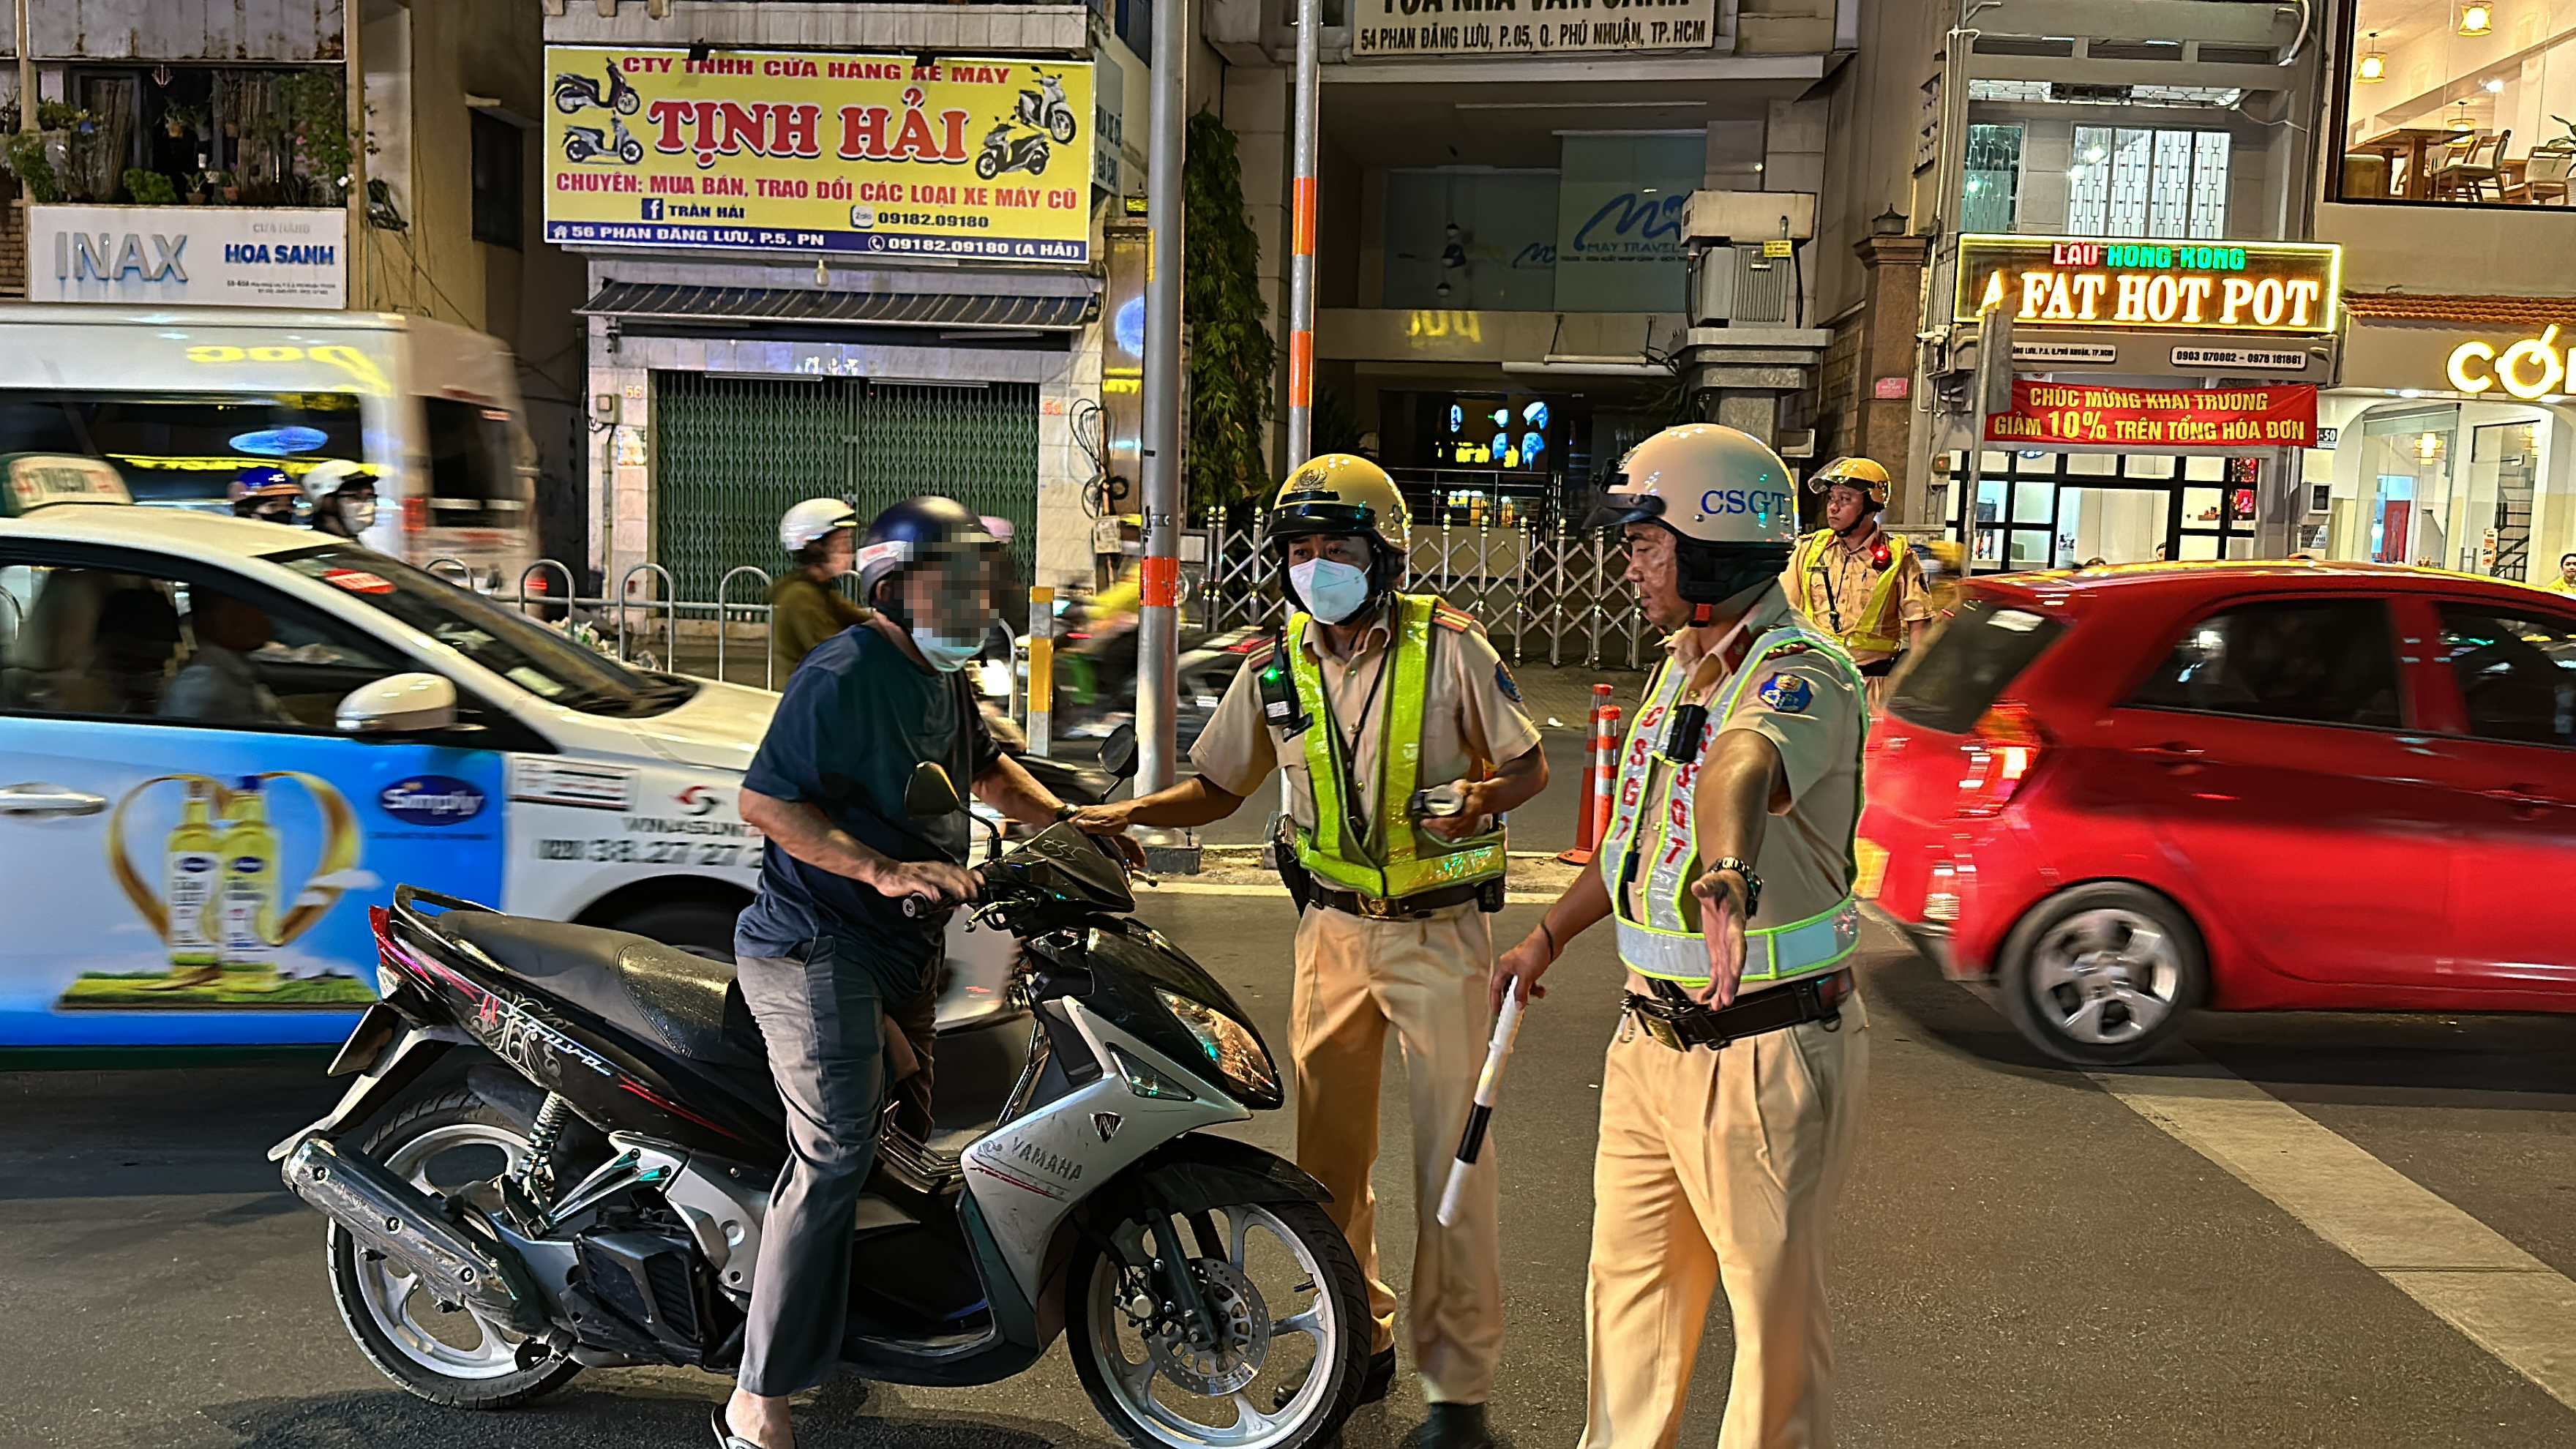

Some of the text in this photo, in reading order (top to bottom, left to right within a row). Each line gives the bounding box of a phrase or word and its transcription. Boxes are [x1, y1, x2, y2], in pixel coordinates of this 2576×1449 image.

[1361, 27, 1376, 49] 54
[1380, 27, 1415, 49] PHAN
[1421, 22, 1458, 48] ĐĂNG
[1540, 24, 1554, 47] Q.
[1560, 19, 1587, 46] PHÚ
[623, 56, 1010, 84] CTY TNHH CỬA HÀNG XE MÁY
[647, 86, 970, 169] TỊNH HẢI
[556, 172, 643, 193] CHUYÊN:
[650, 175, 695, 195] MUA
[756, 179, 808, 199] TRAO
[817, 176, 853, 201] ĐỔI
[861, 181, 902, 203] CÁC
[911, 184, 956, 208] LOẠI
[964, 187, 988, 206] XE
[995, 187, 1041, 209] MÁY
[1047, 188, 1077, 210] CŨ
[878, 211, 989, 228] 09182.09180
[572, 226, 594, 238] 56
[600, 226, 651, 239] PHAN
[657, 226, 708, 242] ĐĂNG
[798, 233, 825, 246] PN
[888, 238, 1079, 258] 09182.09180 (A HẢI)
[1587, 242, 1680, 253] MAY TRAVEL
[55, 231, 189, 282] INAX
[225, 244, 334, 266] HOA SANH
[2106, 244, 2173, 268] HONG
[2180, 246, 2247, 270] KONG
[2017, 272, 2106, 320] FAT
[2113, 274, 2211, 323] HOT
[2219, 277, 2318, 326] POT
[2029, 387, 2268, 411] CHÚC MỪNG KHAI TRƯƠNG
[1994, 411, 2305, 441] GIẢM 10% TRÊN TỔNG HÓA ĐƠN
[1701, 490, 1786, 515] CSGT
[1011, 1136, 1084, 1181] YAMAHA
